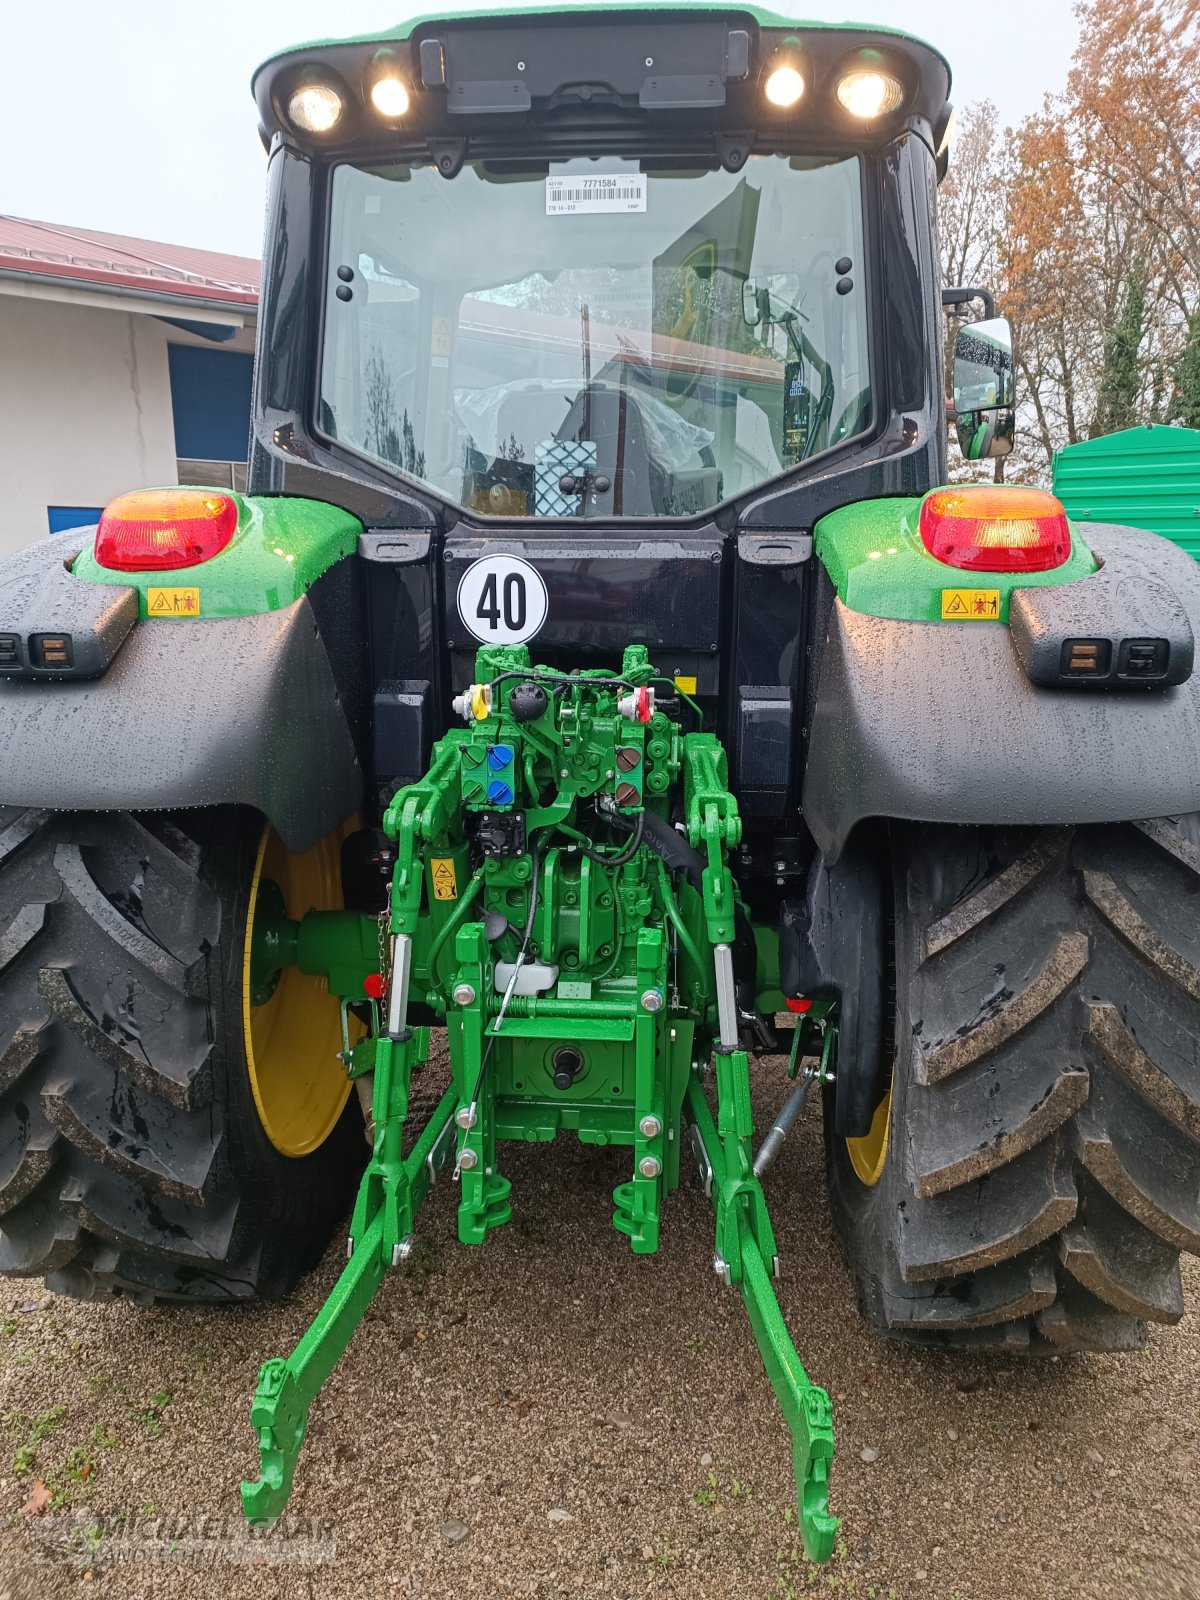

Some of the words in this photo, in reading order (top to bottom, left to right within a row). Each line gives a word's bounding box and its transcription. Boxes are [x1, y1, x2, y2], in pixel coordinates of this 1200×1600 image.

[583, 180, 616, 188] 7771584
[476, 572, 527, 631] 40
[645, 830, 677, 861] Aero
